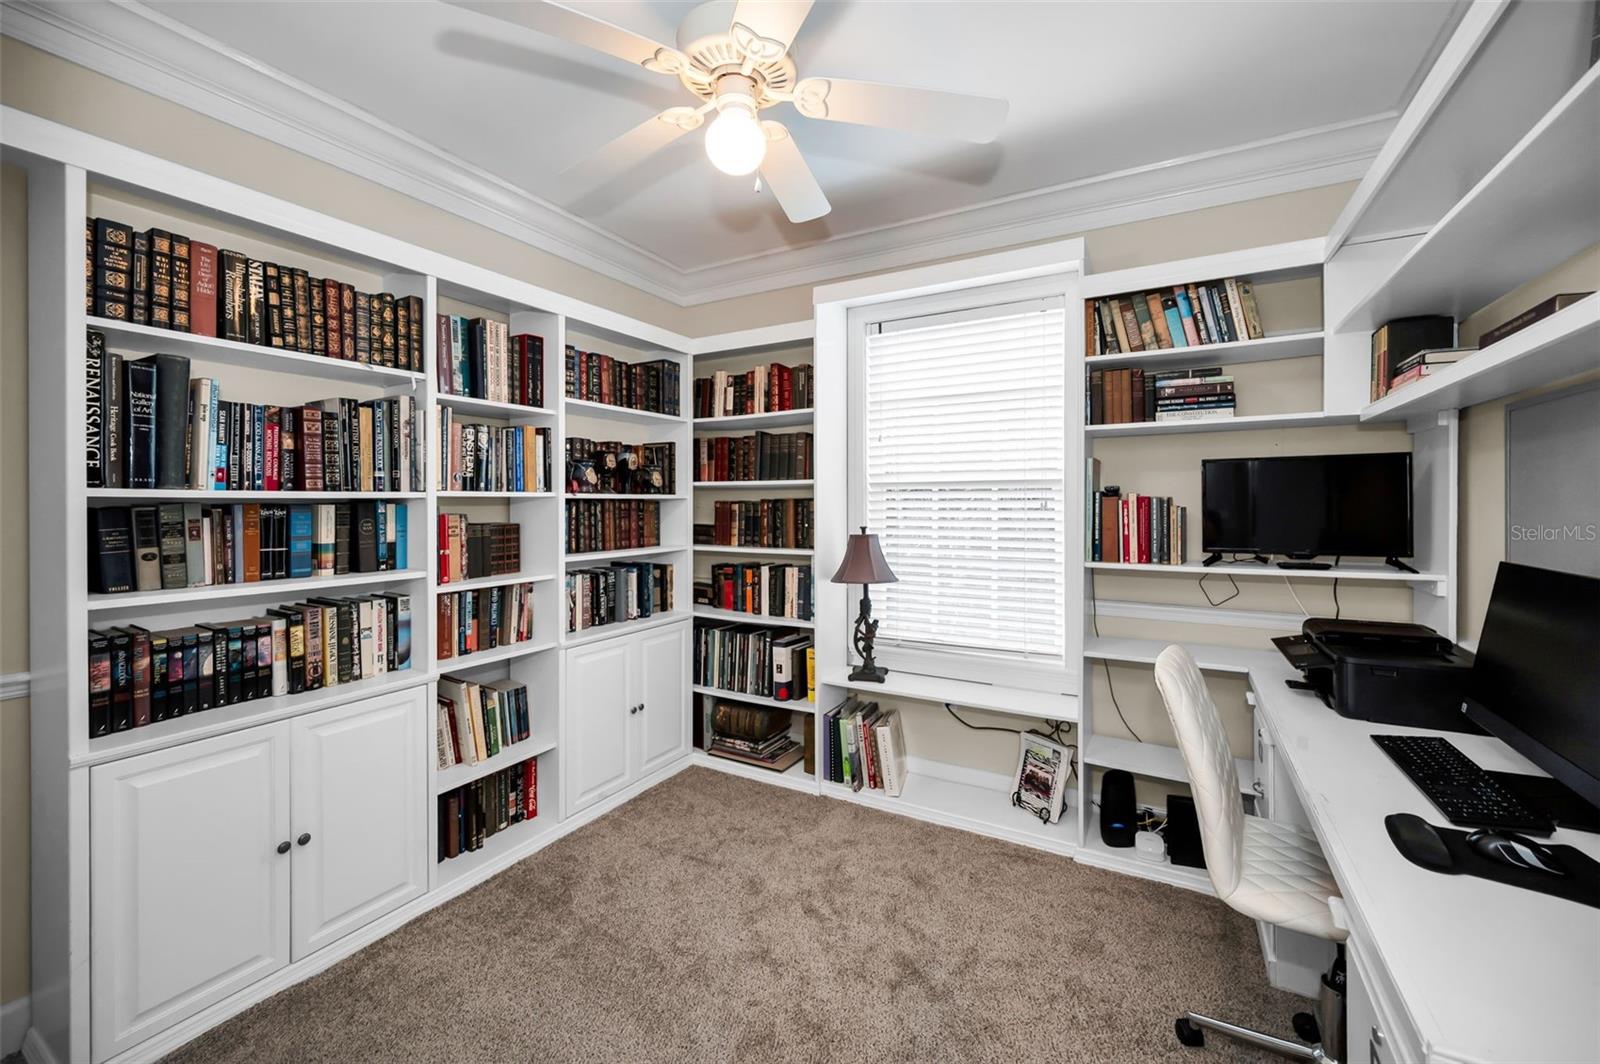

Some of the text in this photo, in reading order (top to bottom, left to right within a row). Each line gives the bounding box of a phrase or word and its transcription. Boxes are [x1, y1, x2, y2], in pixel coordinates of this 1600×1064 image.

[226, 270, 236, 320] Remembers
[130, 391, 156, 399] National
[86, 358, 100, 468] RENAISSANCE
[110, 406, 118, 432] Heritage
[466, 429, 474, 472] EINSTEIN
[310, 610, 320, 620] DAN
[291, 630, 299, 654] MARK
[309, 621, 320, 639] BROWN
[328, 642, 336, 663] LEGACY
